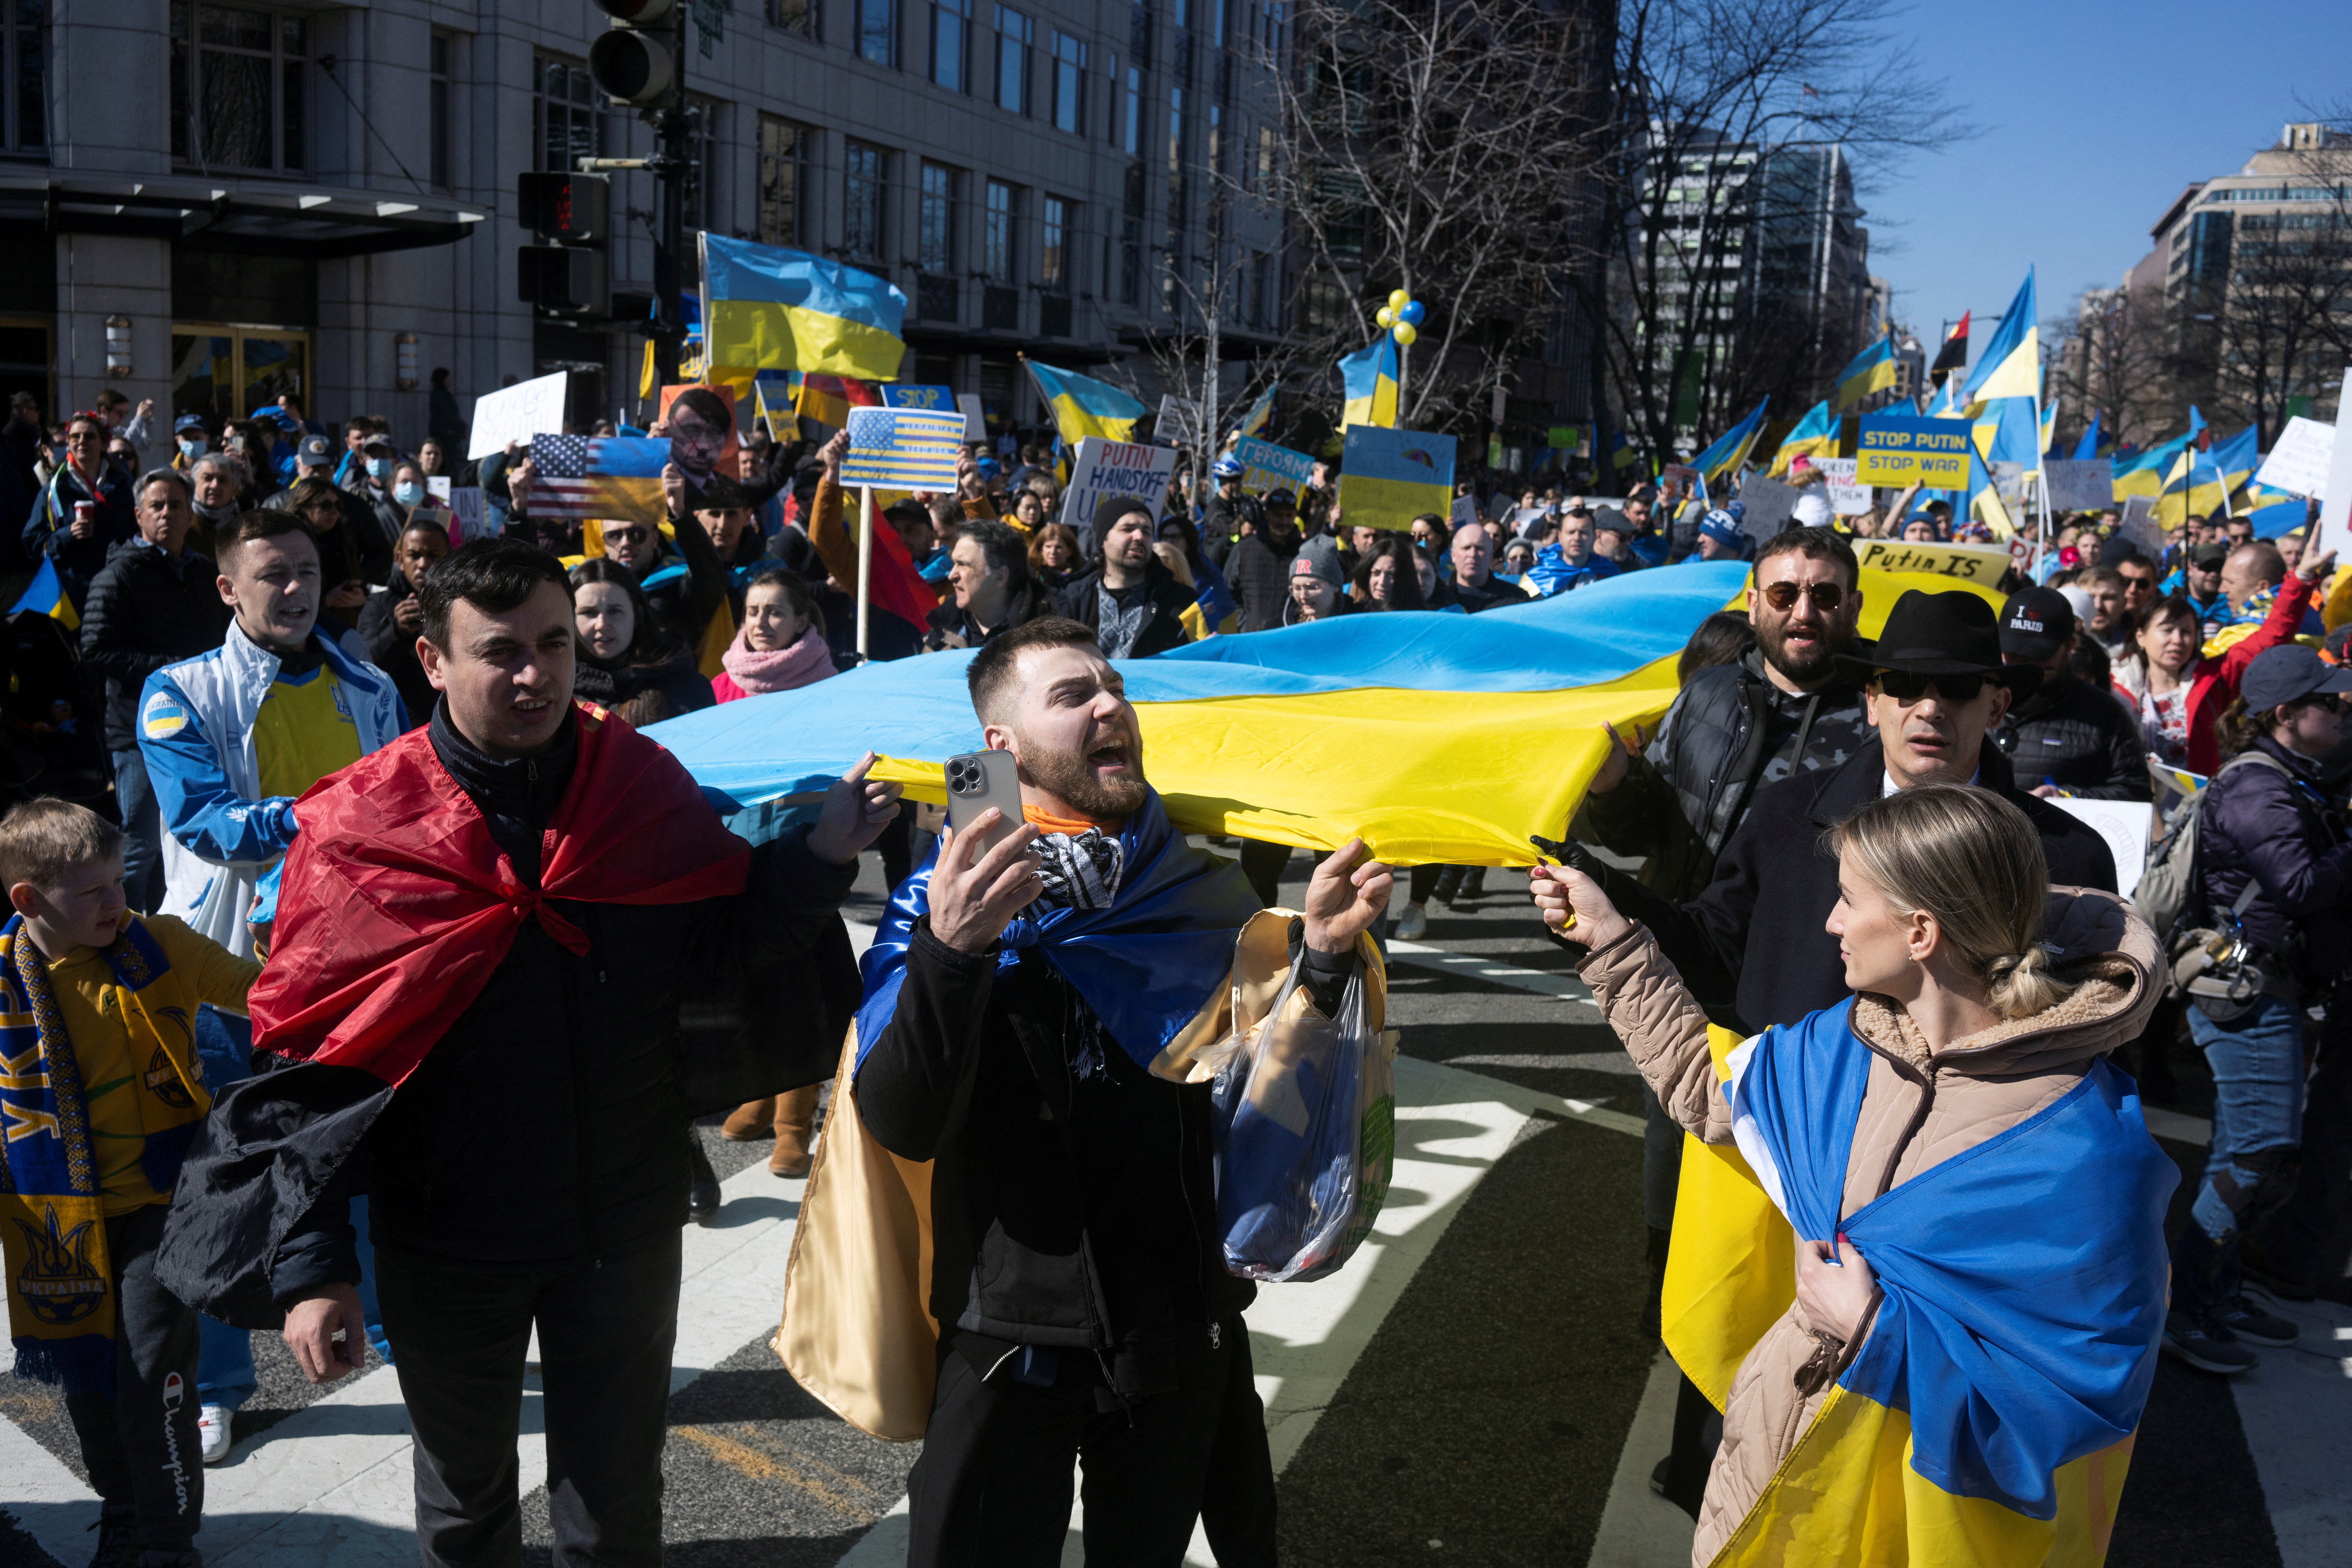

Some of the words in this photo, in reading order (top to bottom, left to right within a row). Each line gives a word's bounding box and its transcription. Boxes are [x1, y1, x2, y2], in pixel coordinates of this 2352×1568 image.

[896, 388, 939, 408] STOP
[904, 423, 956, 433] UKRAINIAN
[1864, 430, 1911, 447] STOP
[1915, 433, 1967, 450] PUTIN
[1100, 442, 1155, 470] PUTIN
[1241, 441, 1310, 479] ГЕРОЯМ
[1868, 455, 1914, 471] STOP
[1920, 457, 1960, 473] WAR
[1295, 559, 1312, 575] R
[1864, 545, 1936, 570] Putin
[1937, 555, 1982, 577] IS
[2016, 605, 2025, 618] I
[2009, 618, 2043, 632] PARIS
[20, 1280, 103, 1296] УКРАЇНА
[162, 1371, 190, 1515] Champion
